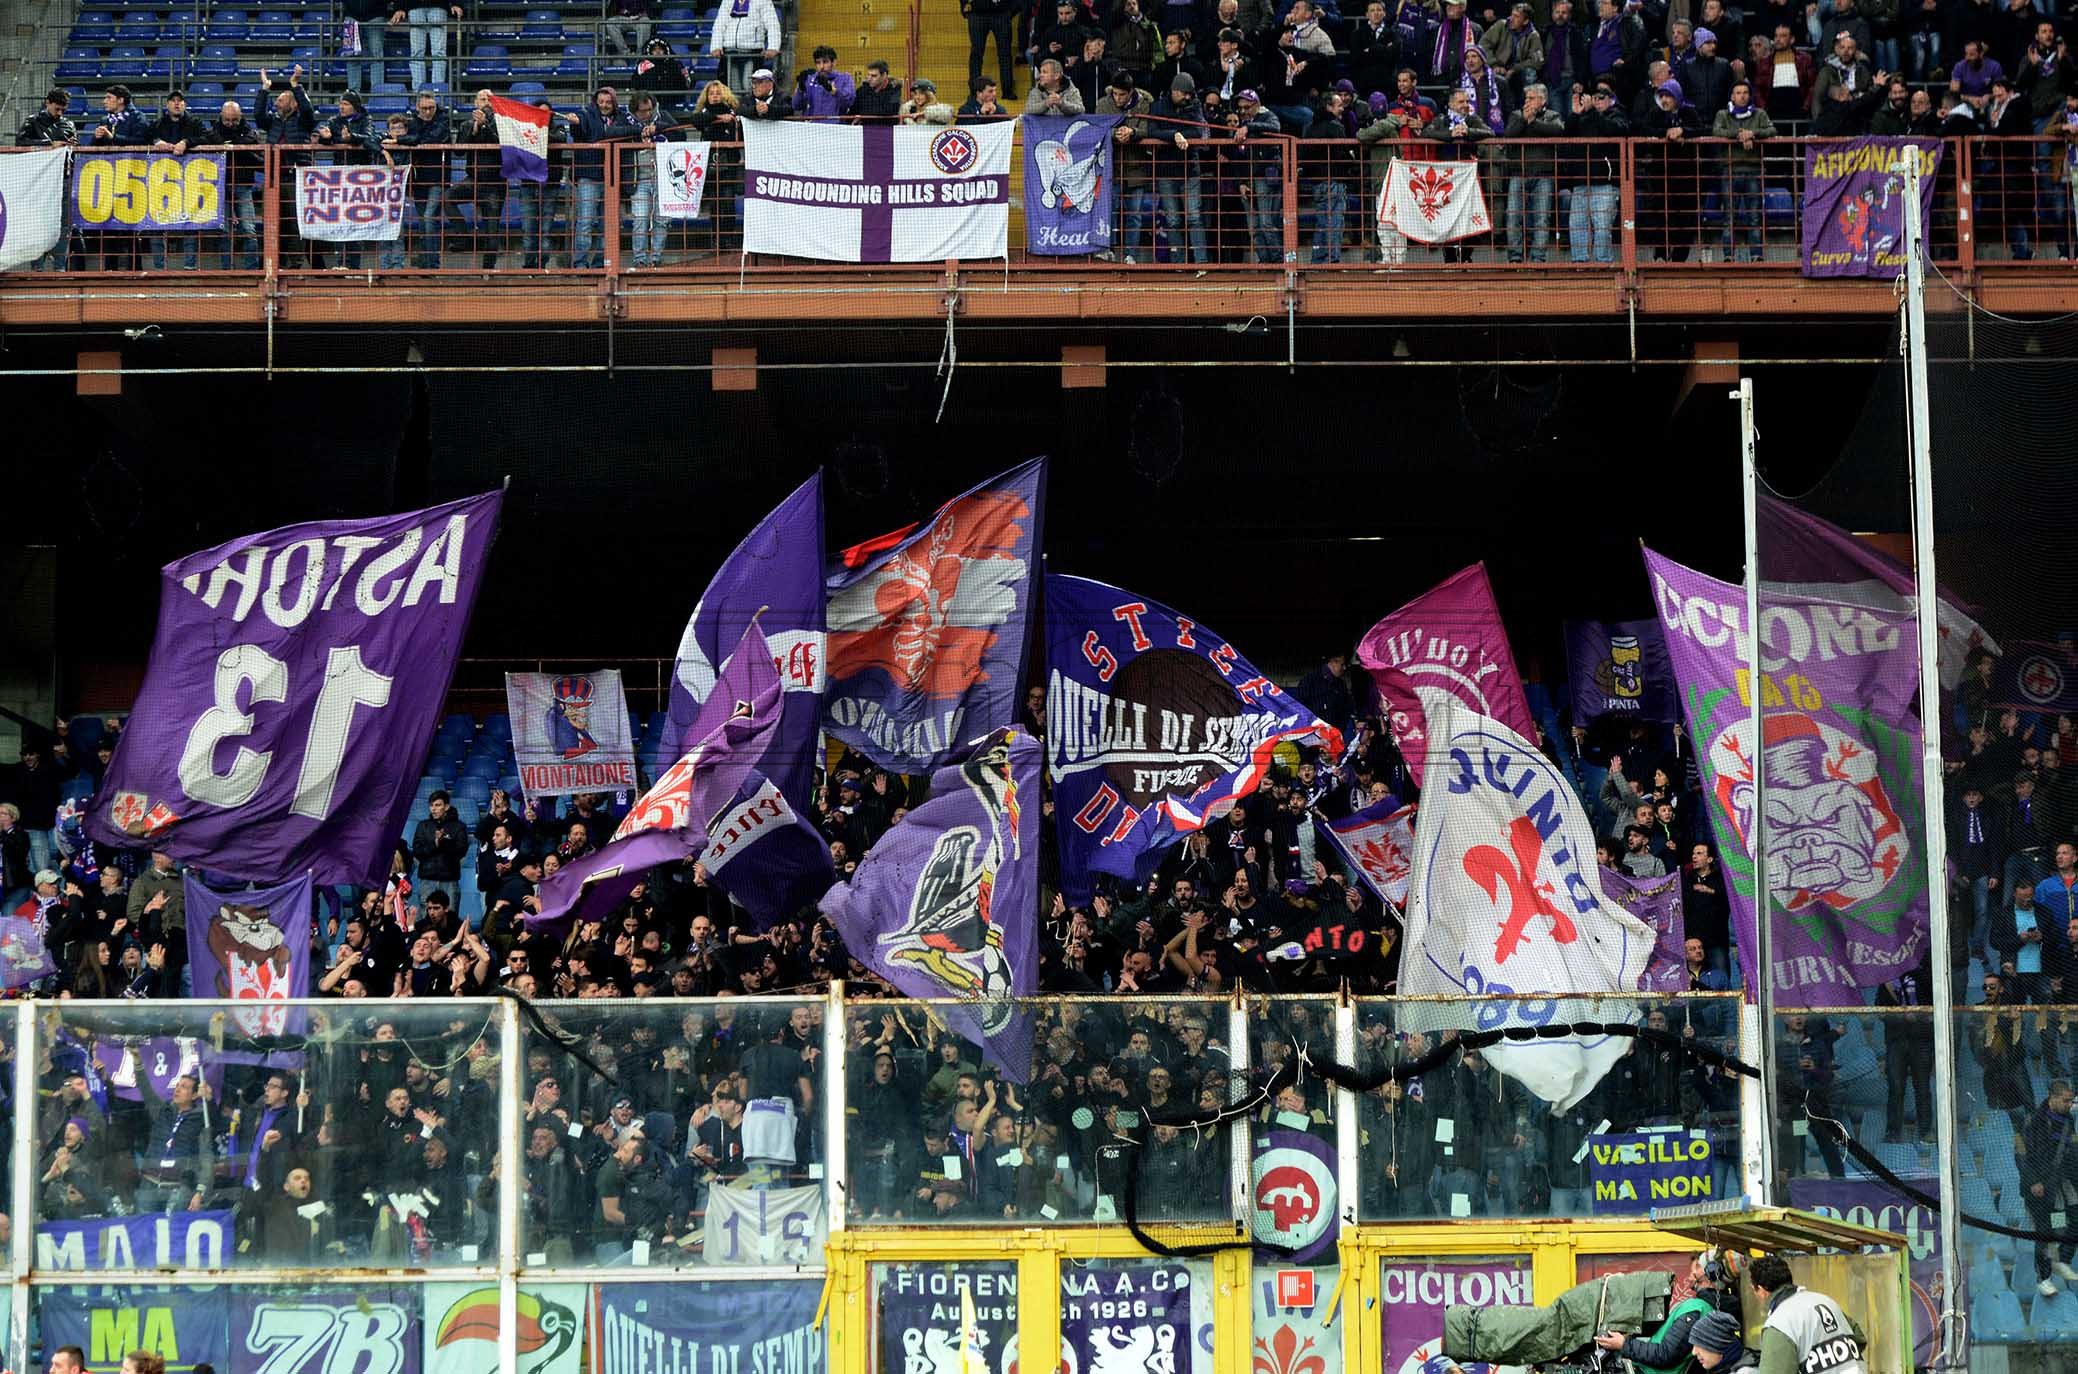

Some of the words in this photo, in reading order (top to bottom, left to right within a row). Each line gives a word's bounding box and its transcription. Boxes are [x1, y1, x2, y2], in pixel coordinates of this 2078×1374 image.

[304, 169, 404, 187] NOI
[756, 176, 882, 204] SURROUNDING
[888, 184, 934, 203] HILLS
[942, 180, 998, 203] SQUAD
[78, 158, 218, 224] 0566
[304, 187, 401, 203] TIFIAMO
[304, 204, 400, 224] NOI
[1811, 251, 1851, 266] Curva
[1047, 668, 1148, 766] QUELLI
[1160, 709, 1194, 752] DI
[521, 760, 633, 790] MONTAIONE
[1595, 1180, 1638, 1201] MA
[1650, 1175, 1711, 1200] NON
[897, 1272, 1100, 1296] FIORENNA
[931, 1303, 1017, 1321] Auust
[1089, 1300, 1147, 1319] 1926
[91, 1307, 178, 1363] MA
